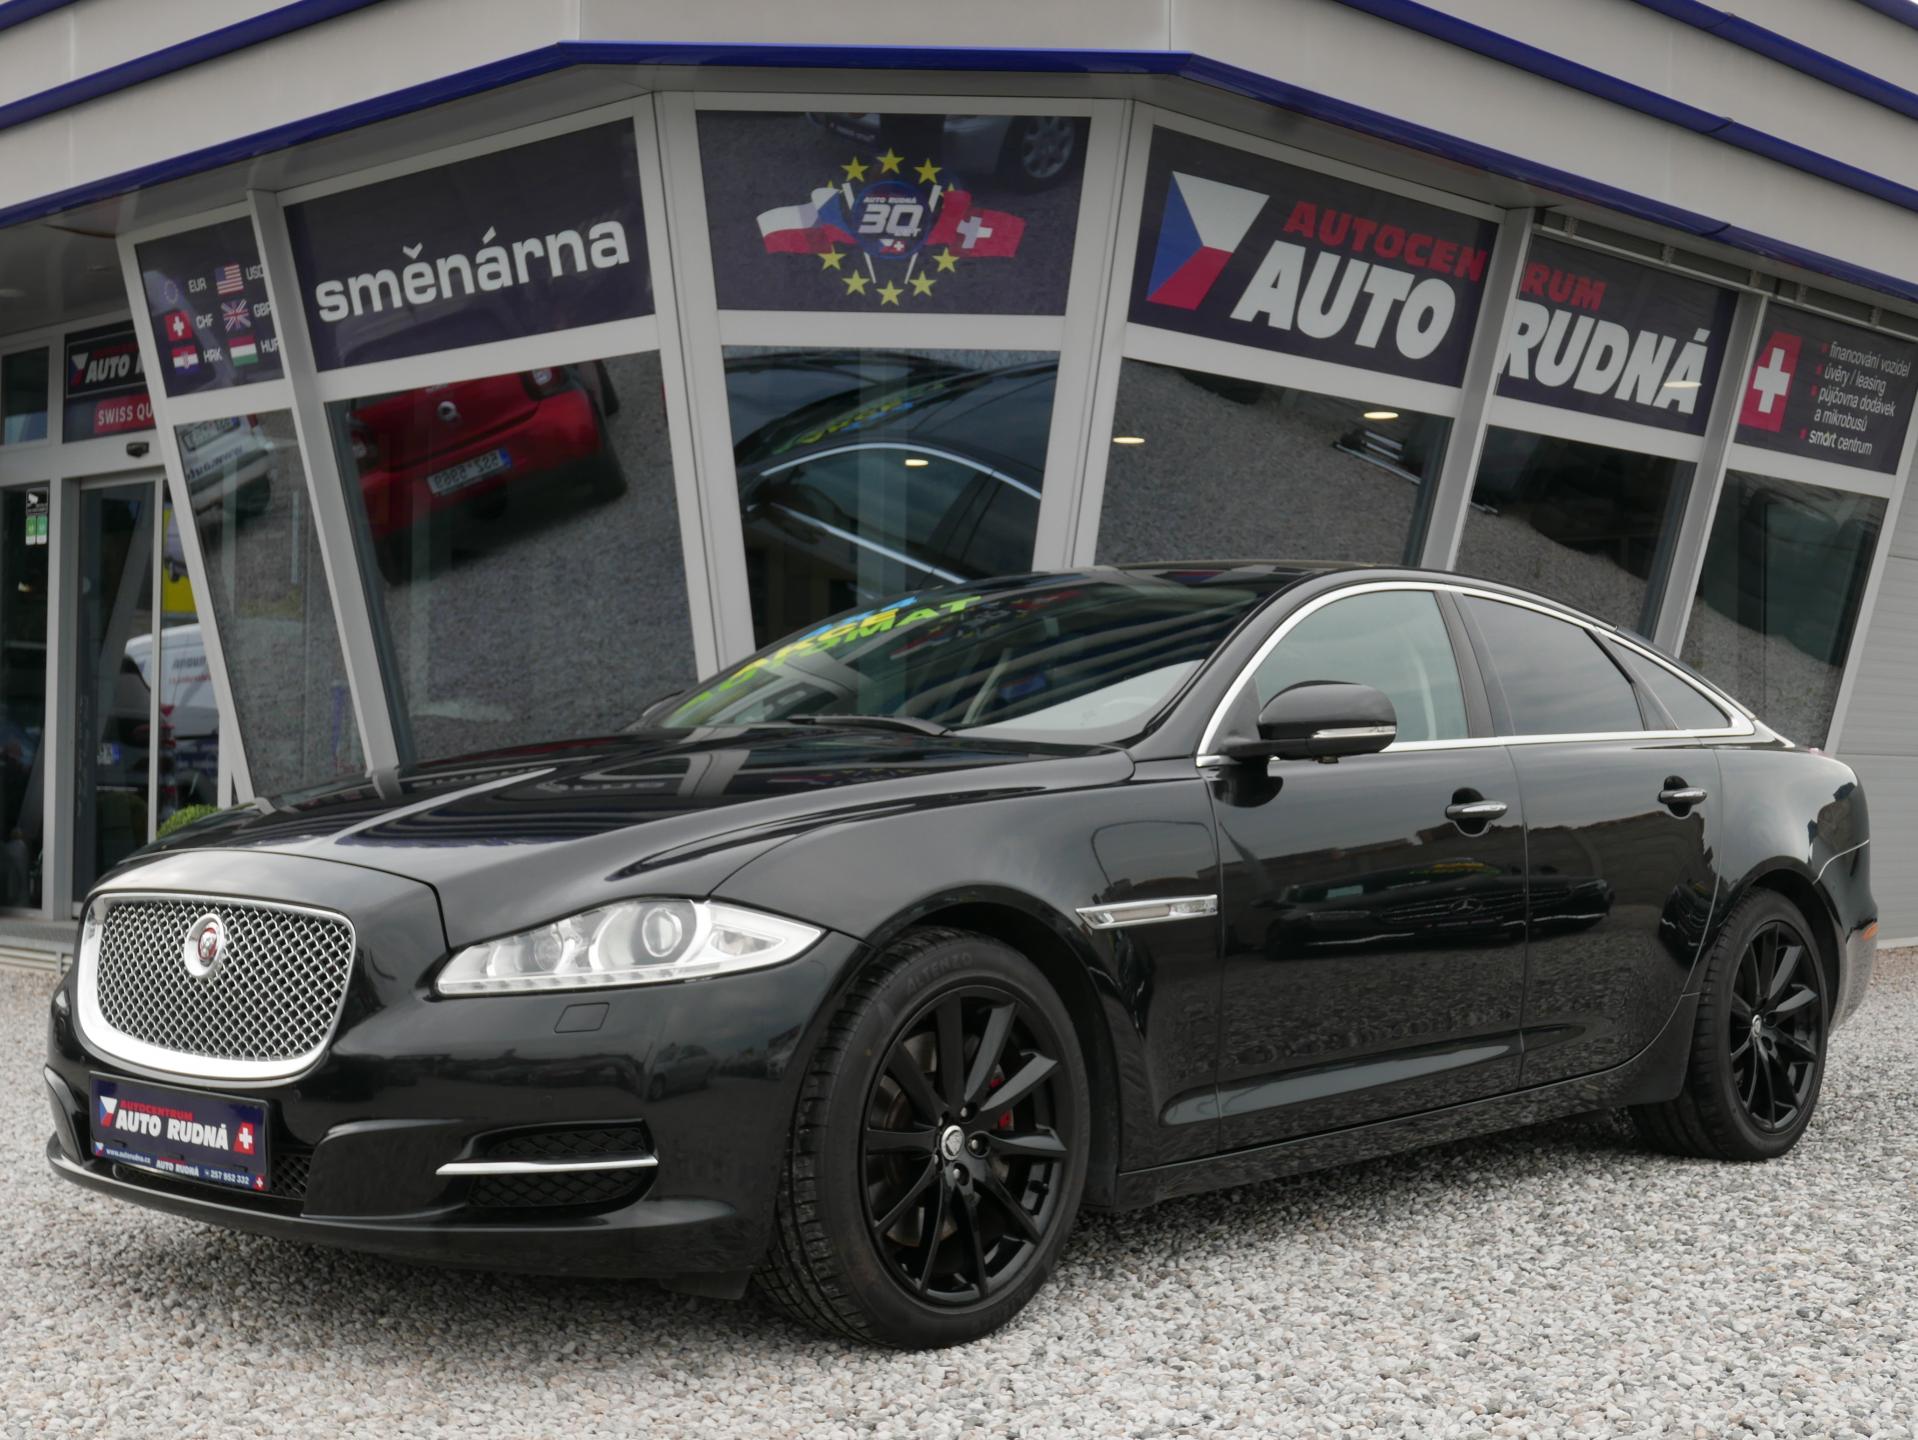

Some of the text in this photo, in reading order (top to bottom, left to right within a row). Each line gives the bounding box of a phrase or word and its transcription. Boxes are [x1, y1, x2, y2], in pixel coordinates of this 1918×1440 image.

[314, 220, 630, 323] směnárna
[188, 277, 207, 293] EUR
[195, 313, 214, 329] CHF
[1230, 239, 1708, 415] AUTO RUDNÁ
[203, 347, 222, 363] HRK
[84, 355, 131, 384] AUTO
[1855, 370, 1887, 396] leasing
[97, 405, 134, 426] SWISS
[1814, 408, 1822, 422] a
[1837, 436, 1873, 455] centrum
[115, 1109, 229, 1151] AUTO RUDNÁ
